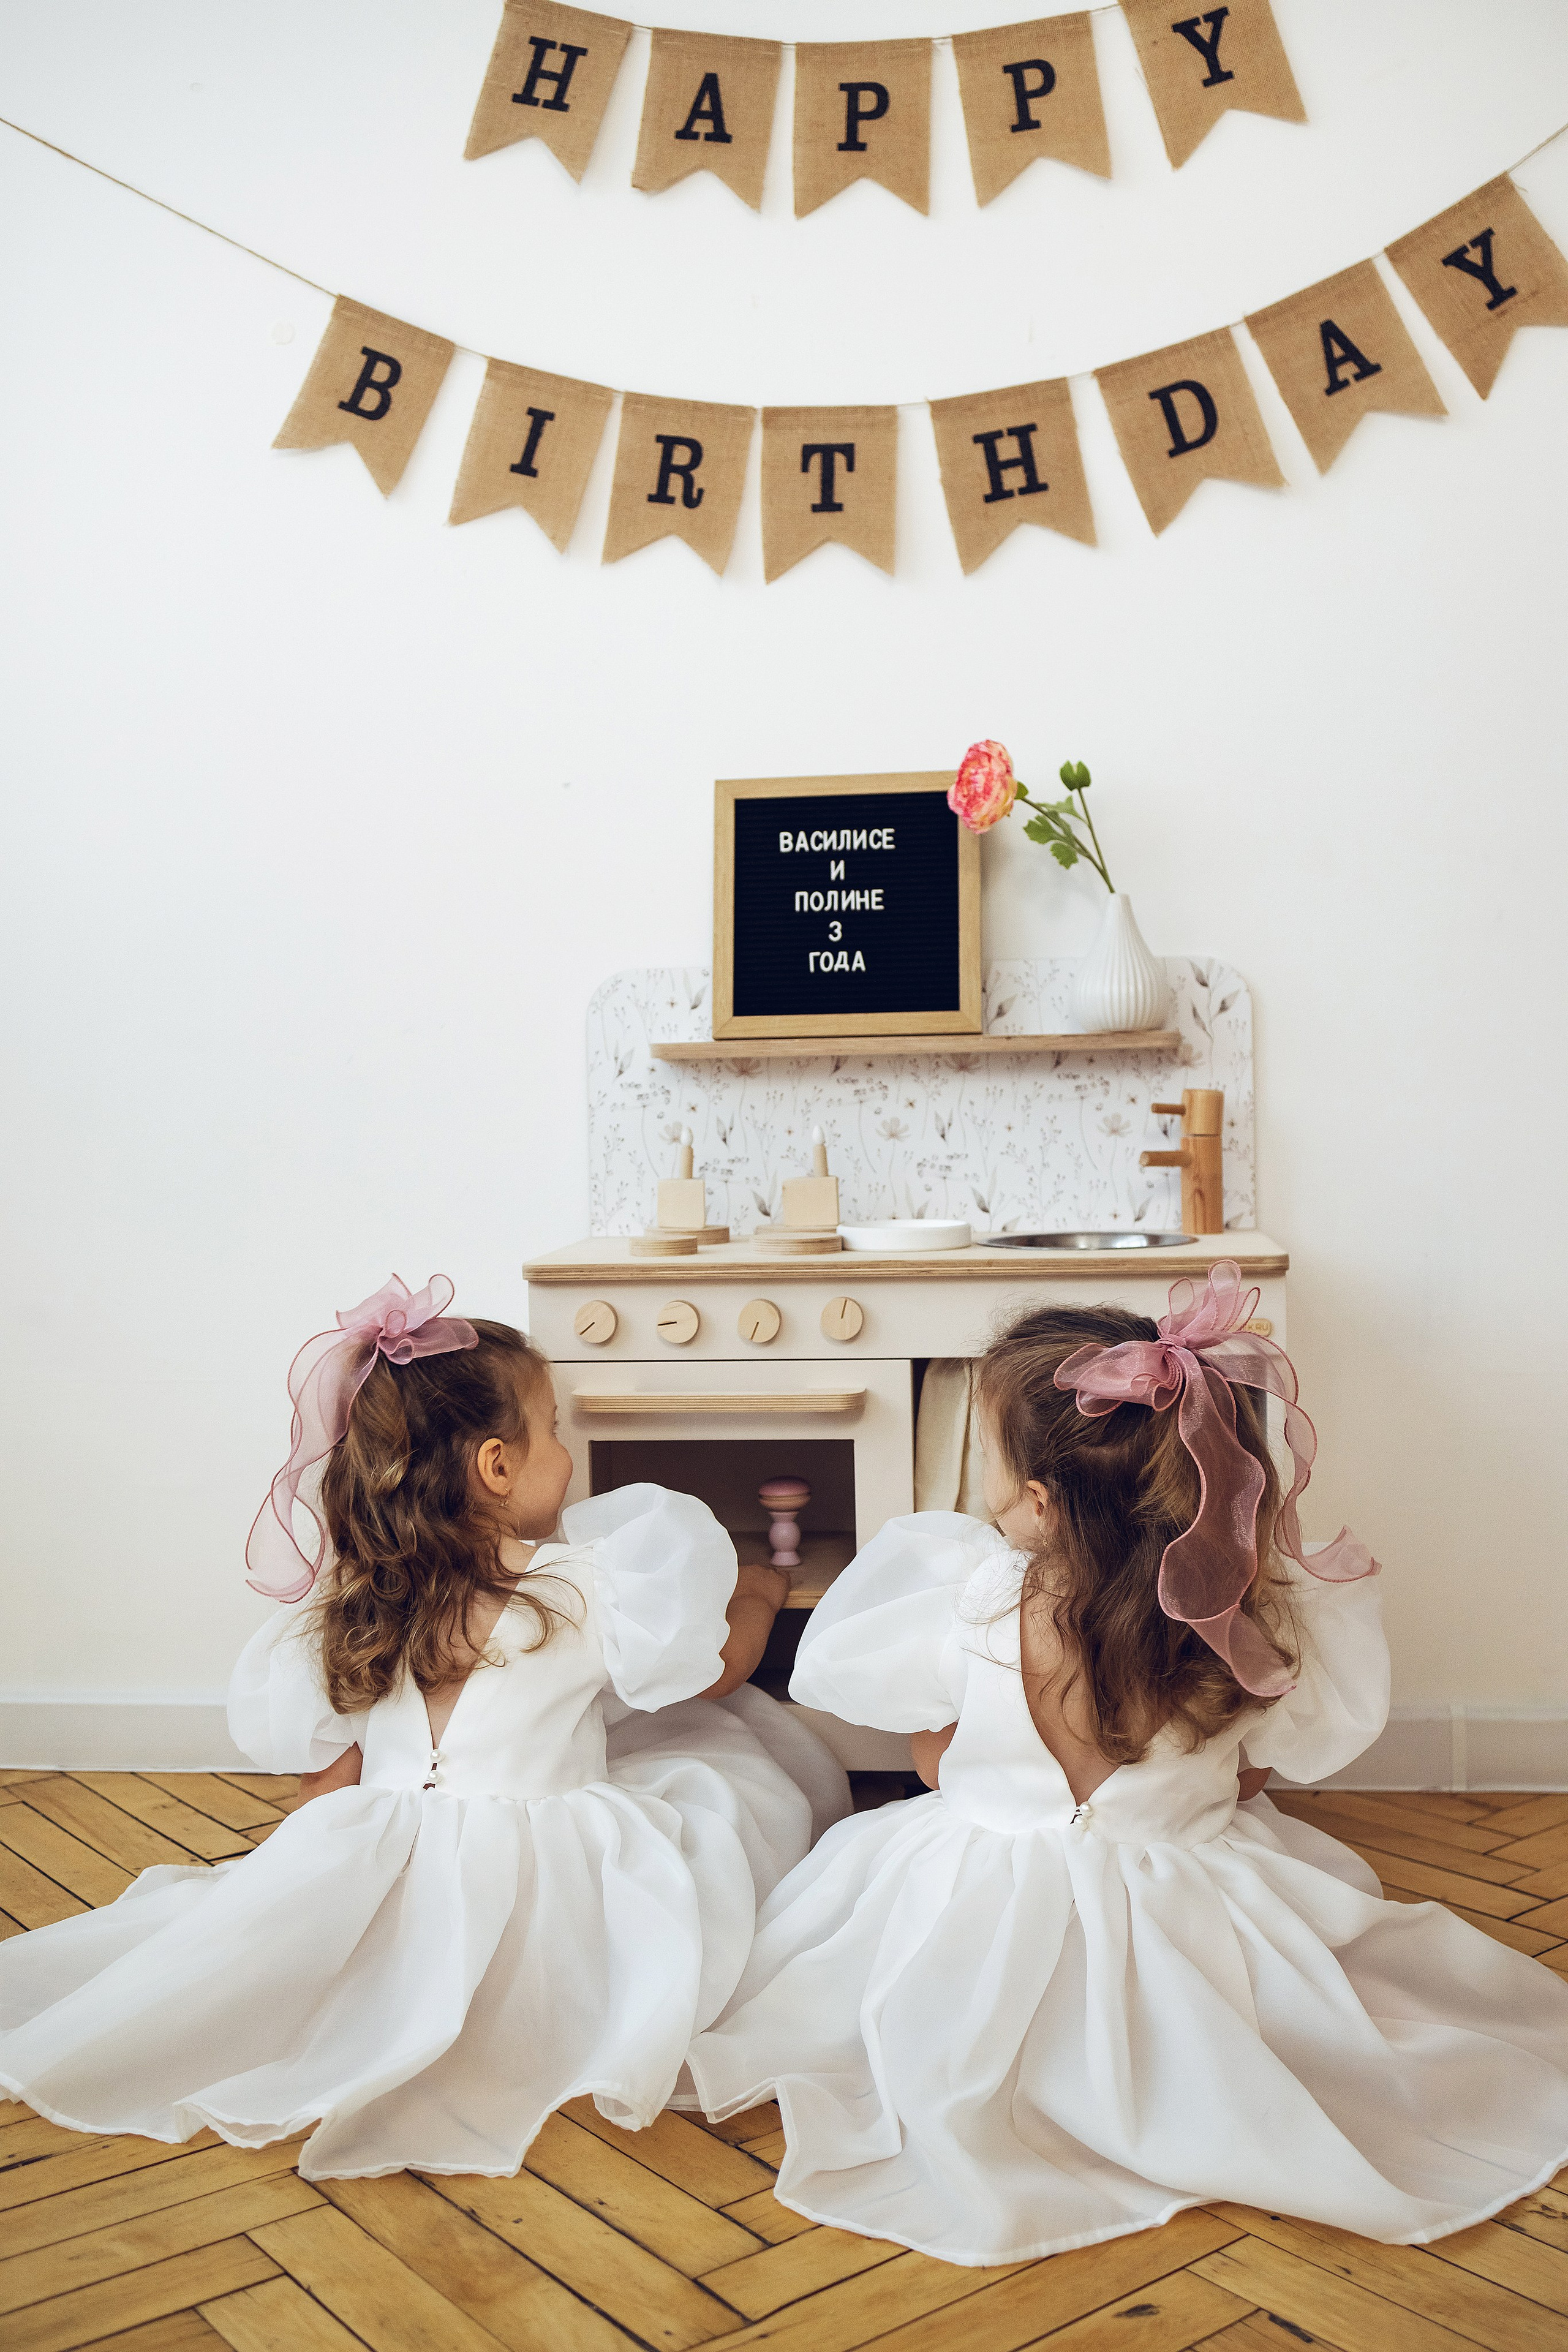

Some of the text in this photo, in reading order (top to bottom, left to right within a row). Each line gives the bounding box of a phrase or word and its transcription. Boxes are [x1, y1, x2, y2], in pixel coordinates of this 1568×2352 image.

[511, 6, 1234, 152] HAPPY
[337, 228, 1518, 513] BIRTHDAY
[779, 829, 895, 853] ВАСИЛИСЕ
[830, 860, 845, 881] И
[795, 889, 884, 911] ПОЛИНЕ
[828, 921, 842, 941] 3
[809, 951, 866, 972] ГОДА
